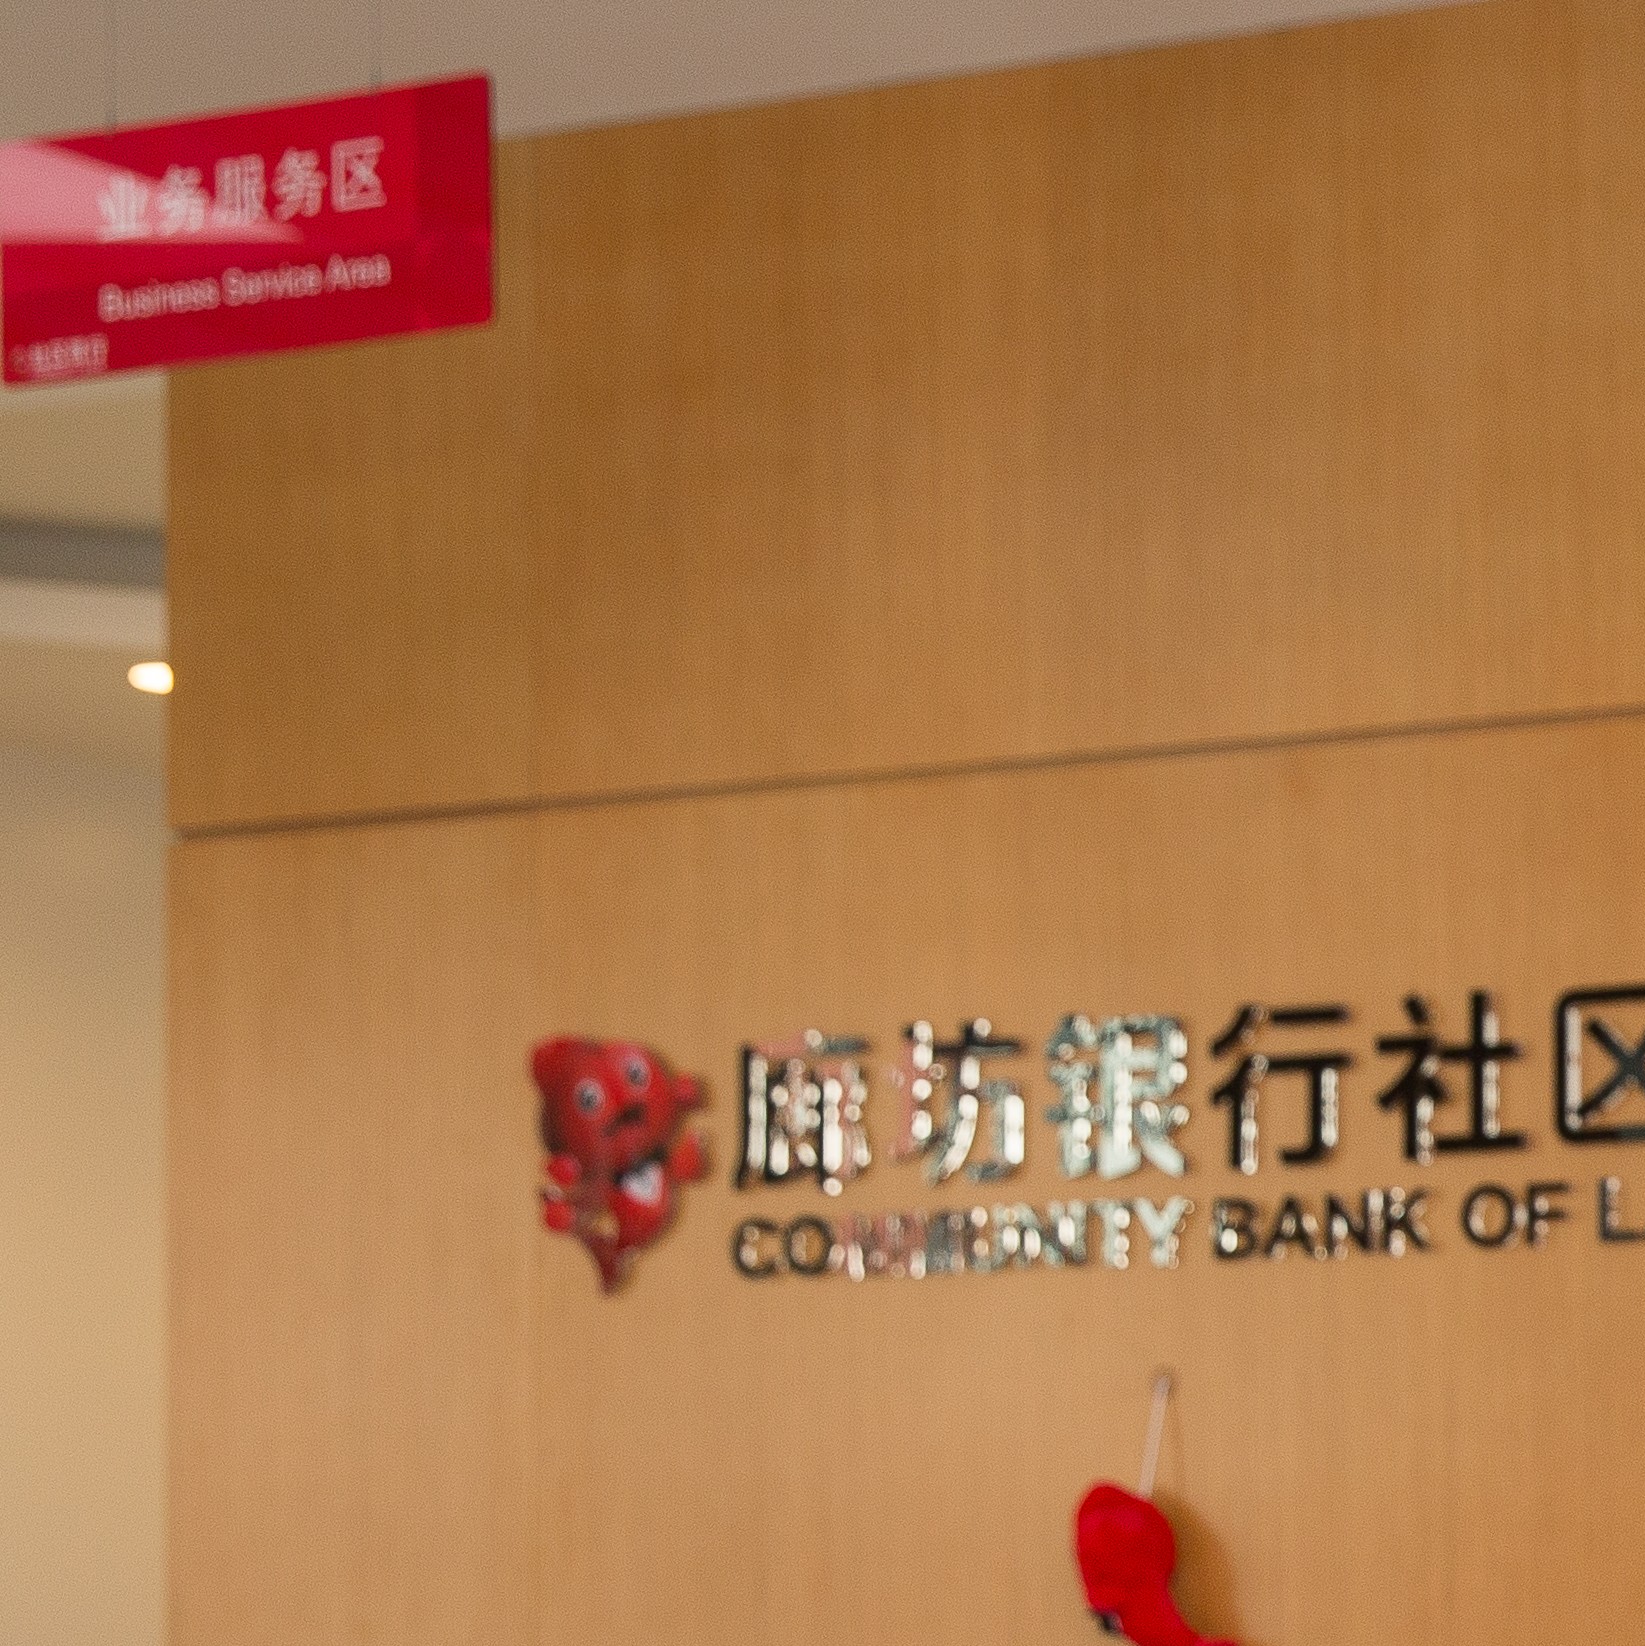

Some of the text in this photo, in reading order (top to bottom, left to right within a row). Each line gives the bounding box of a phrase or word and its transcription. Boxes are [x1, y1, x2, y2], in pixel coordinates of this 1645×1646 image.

[100, 136, 387, 242] 业务服务区
[99, 254, 392, 321] Business Service Area
[1213, 1186, 1432, 1262] BANK
[1459, 1178, 1572, 1248] OF
